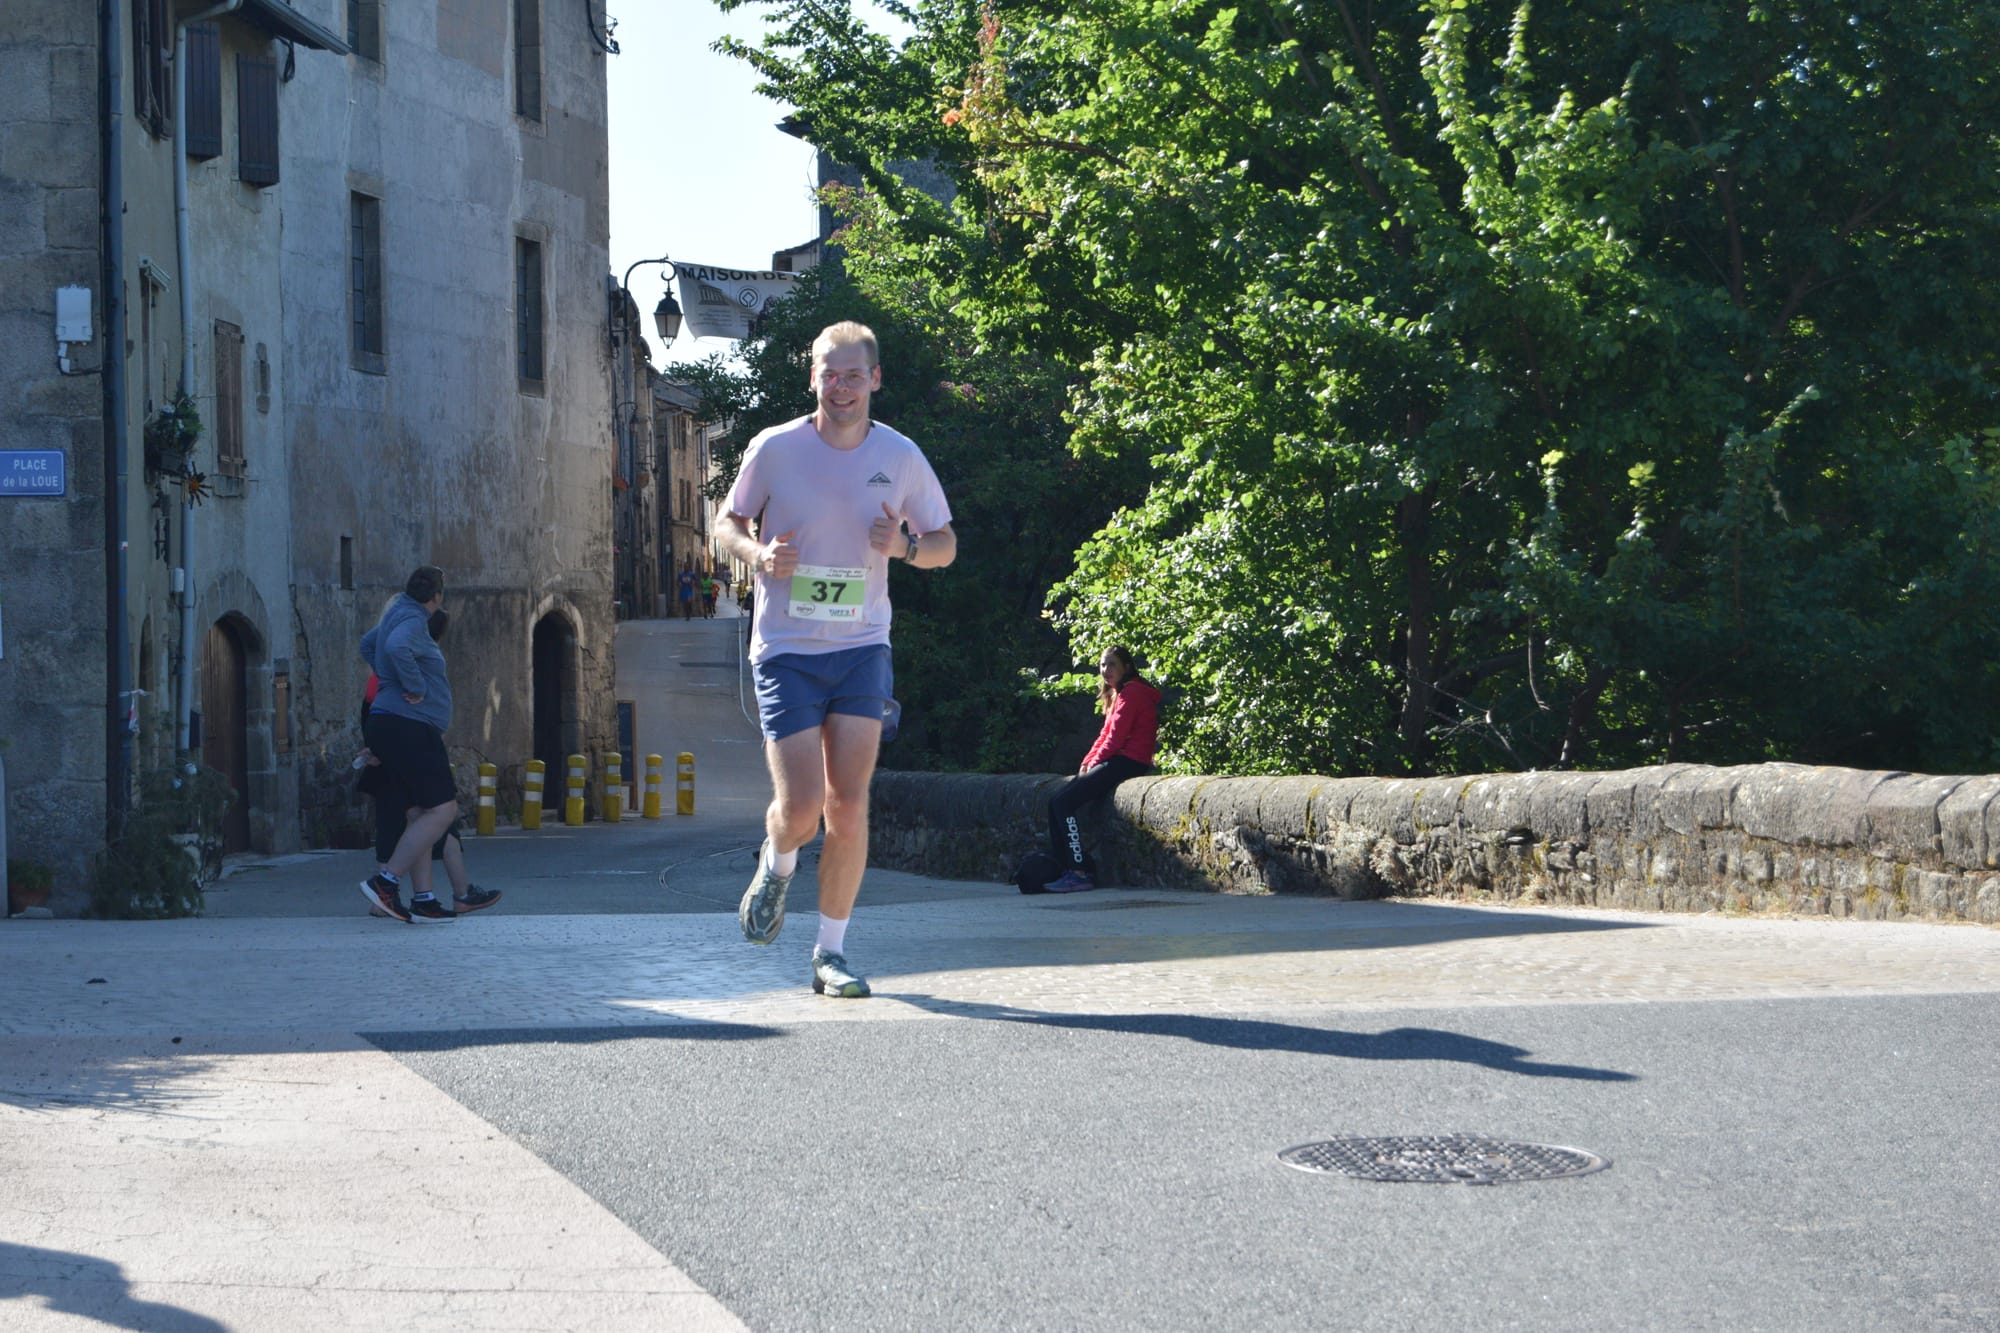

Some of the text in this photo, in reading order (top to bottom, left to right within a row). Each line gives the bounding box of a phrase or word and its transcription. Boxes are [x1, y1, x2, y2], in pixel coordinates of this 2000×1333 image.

[681, 266, 756, 281] MAISON
[763, 271, 788, 281] DE
[14, 459, 47, 471] PLACE
[3, 475, 59, 487] de la LOUE
[811, 581, 847, 603] 37
[1066, 816, 1083, 863] adidas
